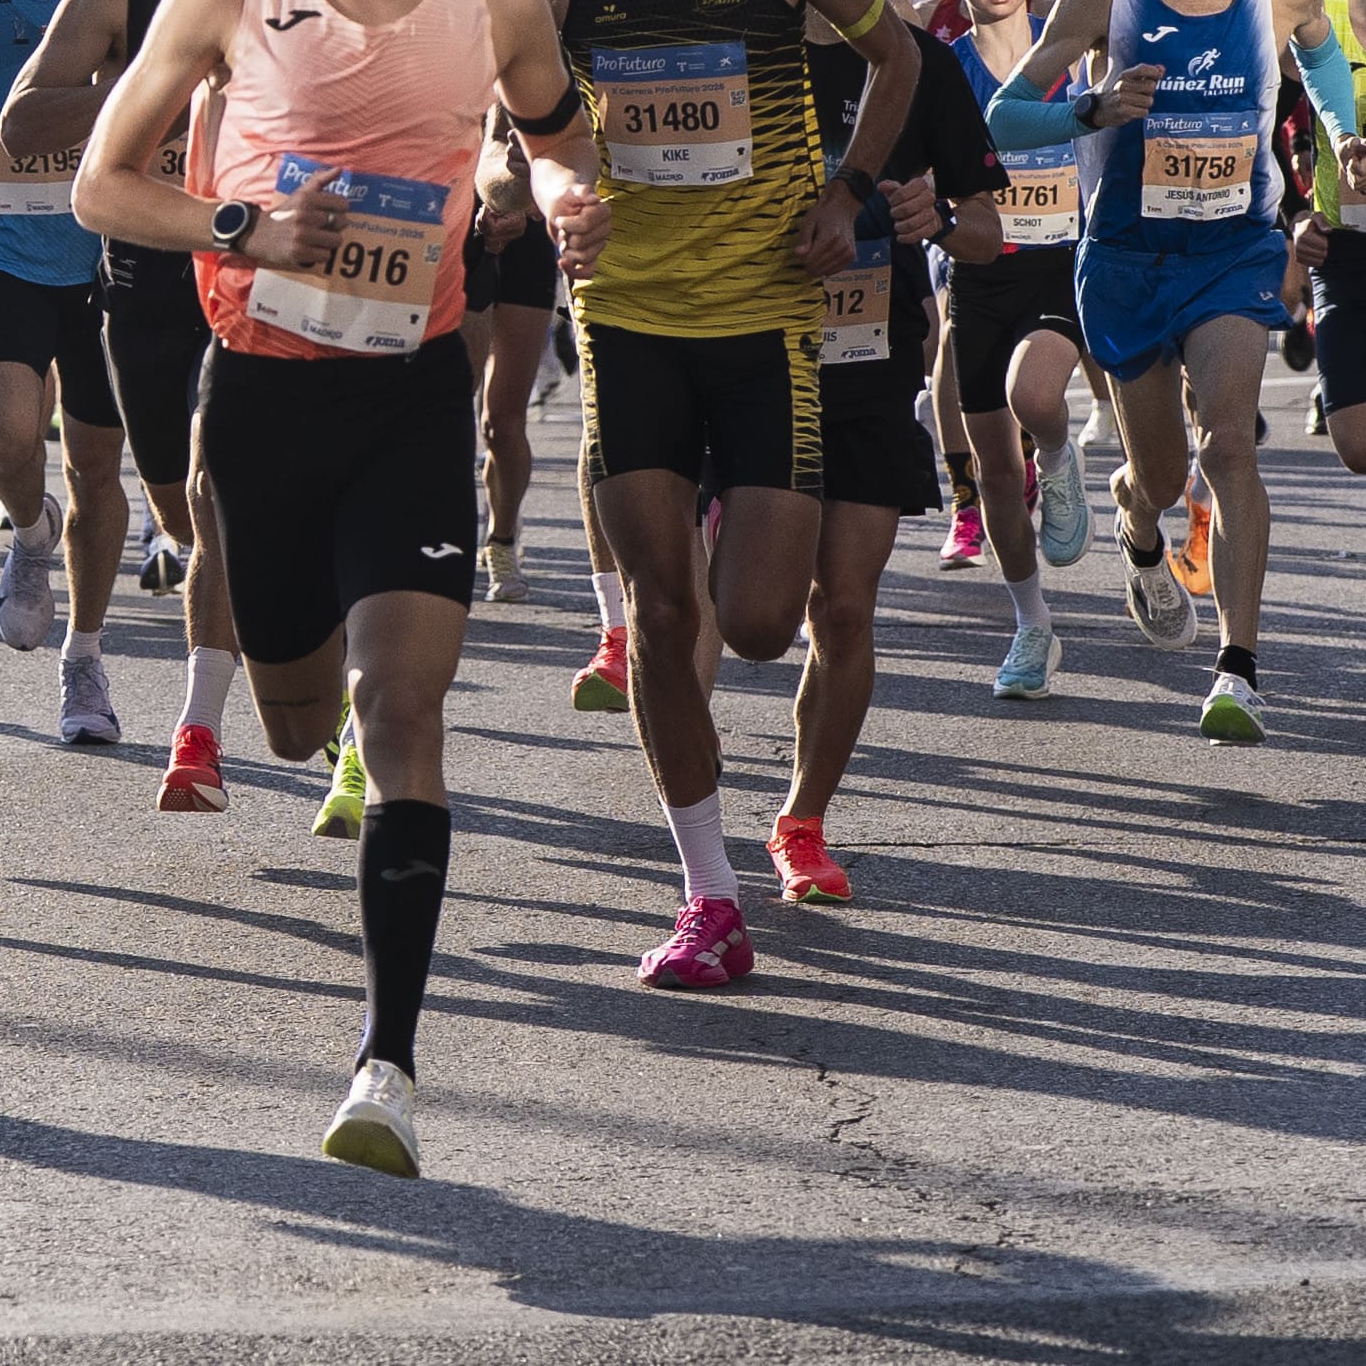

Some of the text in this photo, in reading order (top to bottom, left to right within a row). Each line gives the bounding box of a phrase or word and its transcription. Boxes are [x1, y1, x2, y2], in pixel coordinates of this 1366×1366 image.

[596, 55, 667, 72] ProFuturo
[1209, 74, 1246, 90] Run
[623, 100, 720, 134] 31480
[1146, 117, 1203, 131] ProFuturo
[10, 150, 83, 174] 32195
[662, 149, 691, 162] KIKE
[1164, 154, 1237, 181] 31758
[994, 184, 1059, 207] 31761
[1164, 188, 1231, 203] JESÚS ANTONIO
[1013, 218, 1043, 227] SCHOT
[298, 241, 411, 286] 1916
